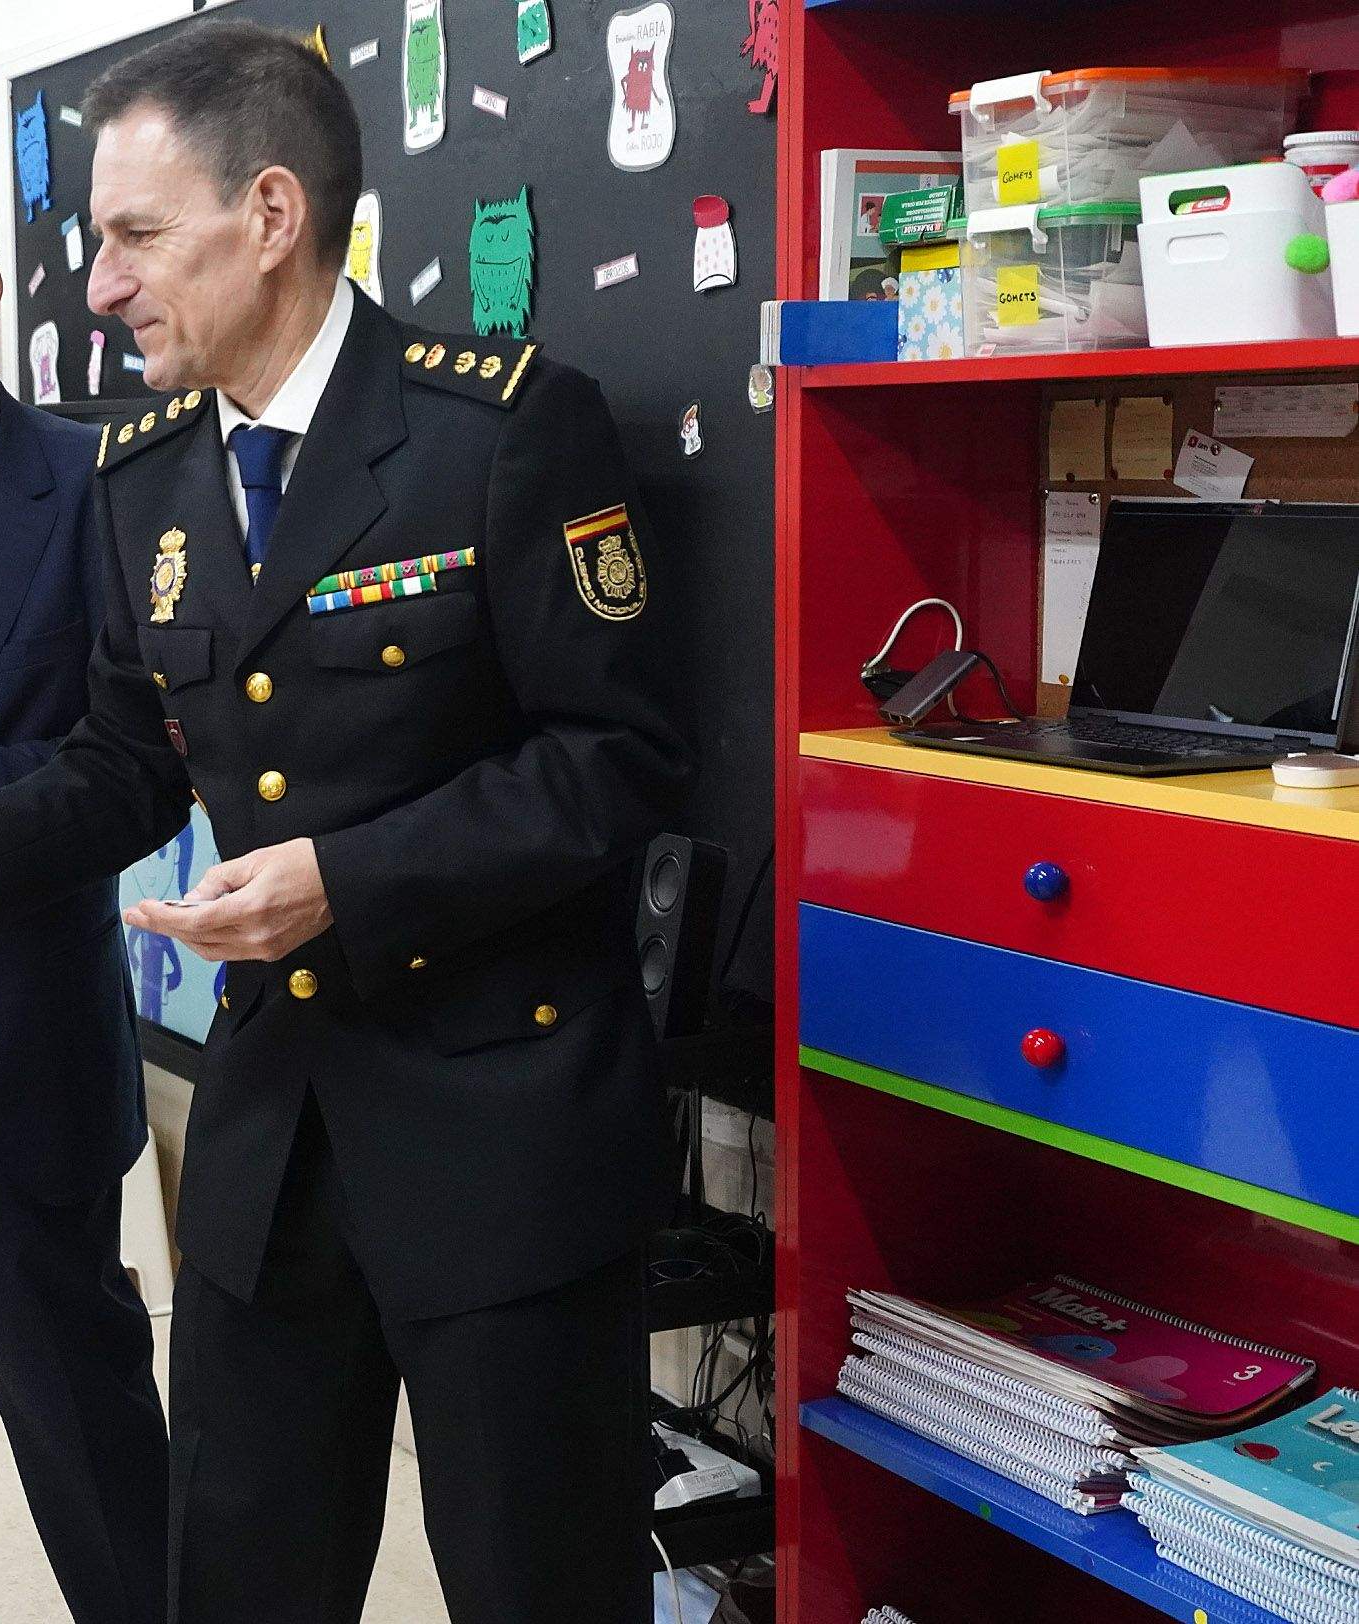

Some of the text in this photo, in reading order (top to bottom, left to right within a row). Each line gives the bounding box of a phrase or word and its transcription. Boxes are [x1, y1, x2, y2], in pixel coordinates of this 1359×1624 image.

[638, 20, 666, 40] RABIA
[904, 224, 934, 234] PARKSIDE
[999, 291, 1037, 304] GOMETS
[575, 546, 596, 600] CUERPO
[593, 598, 642, 615] NACIONAL
[1027, 1287, 1128, 1331] Mate+
[1233, 1365, 1262, 1381] 3
